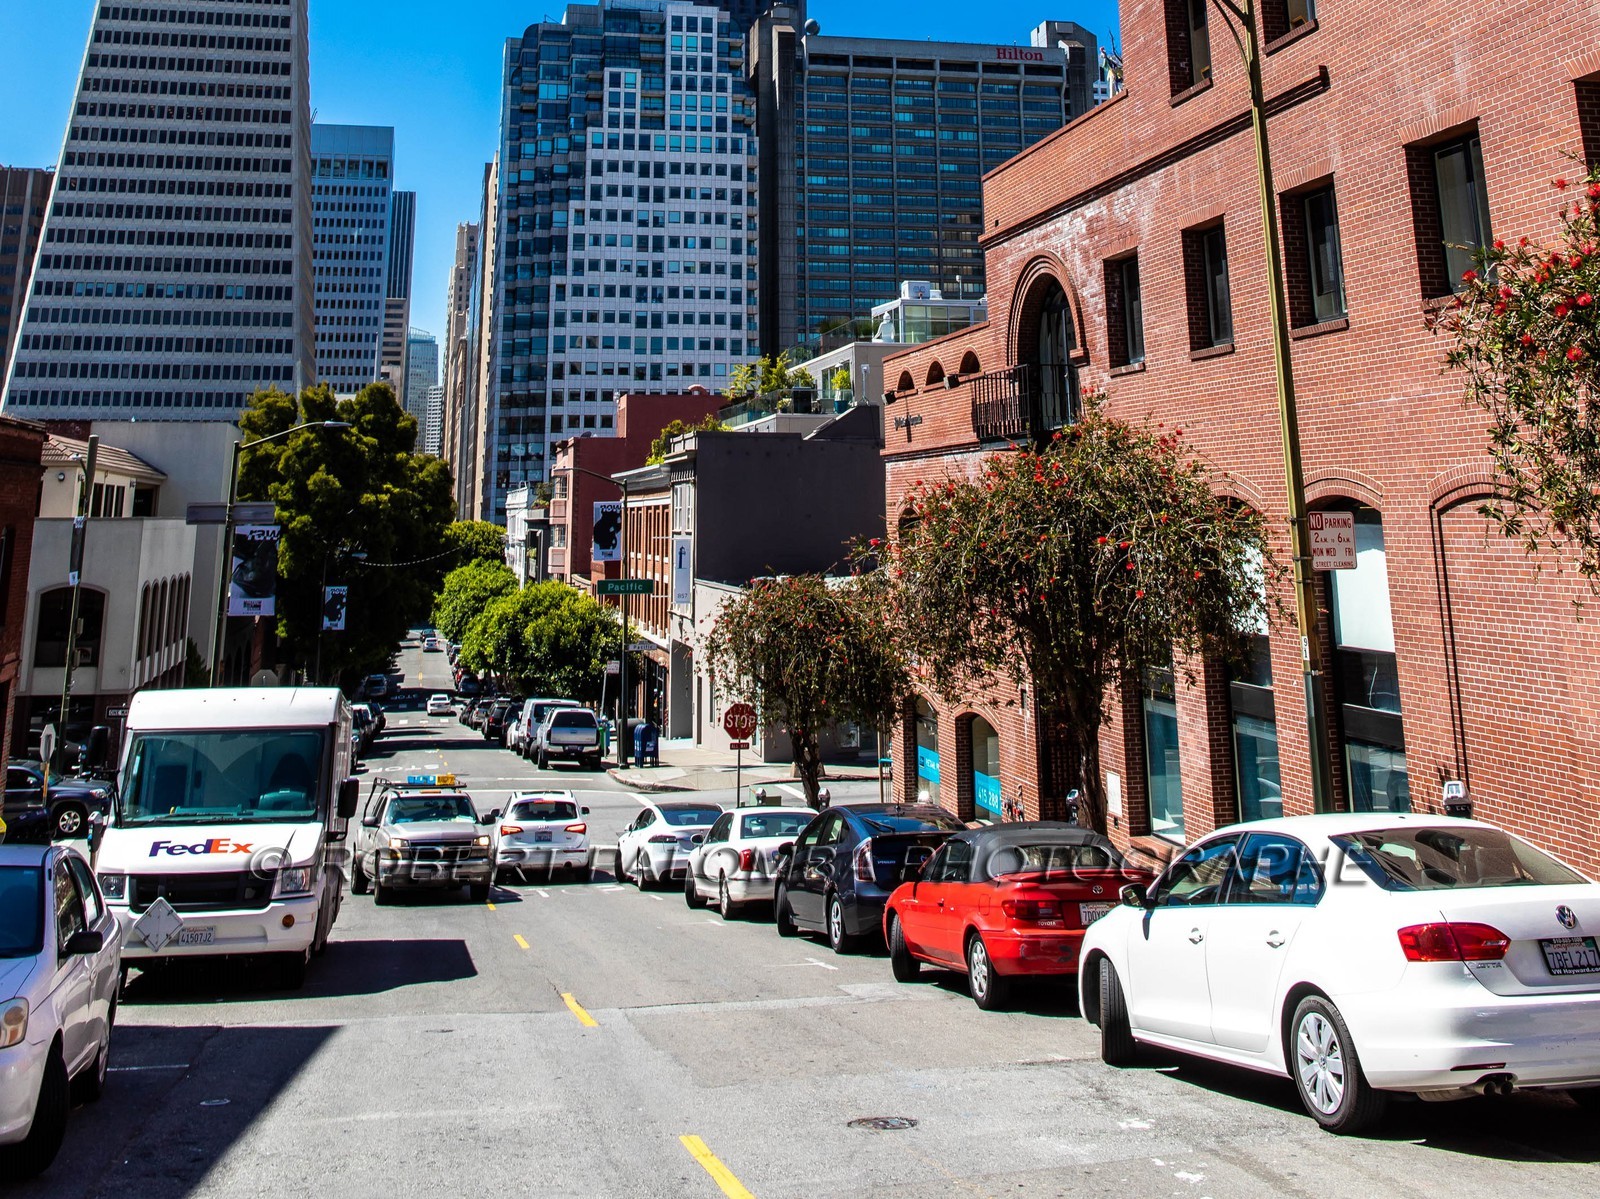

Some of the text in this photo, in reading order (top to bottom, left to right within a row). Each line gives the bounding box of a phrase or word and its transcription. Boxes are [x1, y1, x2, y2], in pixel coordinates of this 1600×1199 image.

[996, 47, 1044, 61] Hilton
[1310, 514, 1352, 529] NO PARKING
[1314, 532, 1320, 543] 2
[1337, 532, 1343, 543] 6
[1312, 547, 1354, 557] MON WED FRI
[607, 583, 643, 591] Pacific
[726, 714, 756, 729] STOP
[978, 787, 999, 810] 415 288
[149, 838, 254, 858] FedEx
[181, 933, 212, 944] 41507J2
